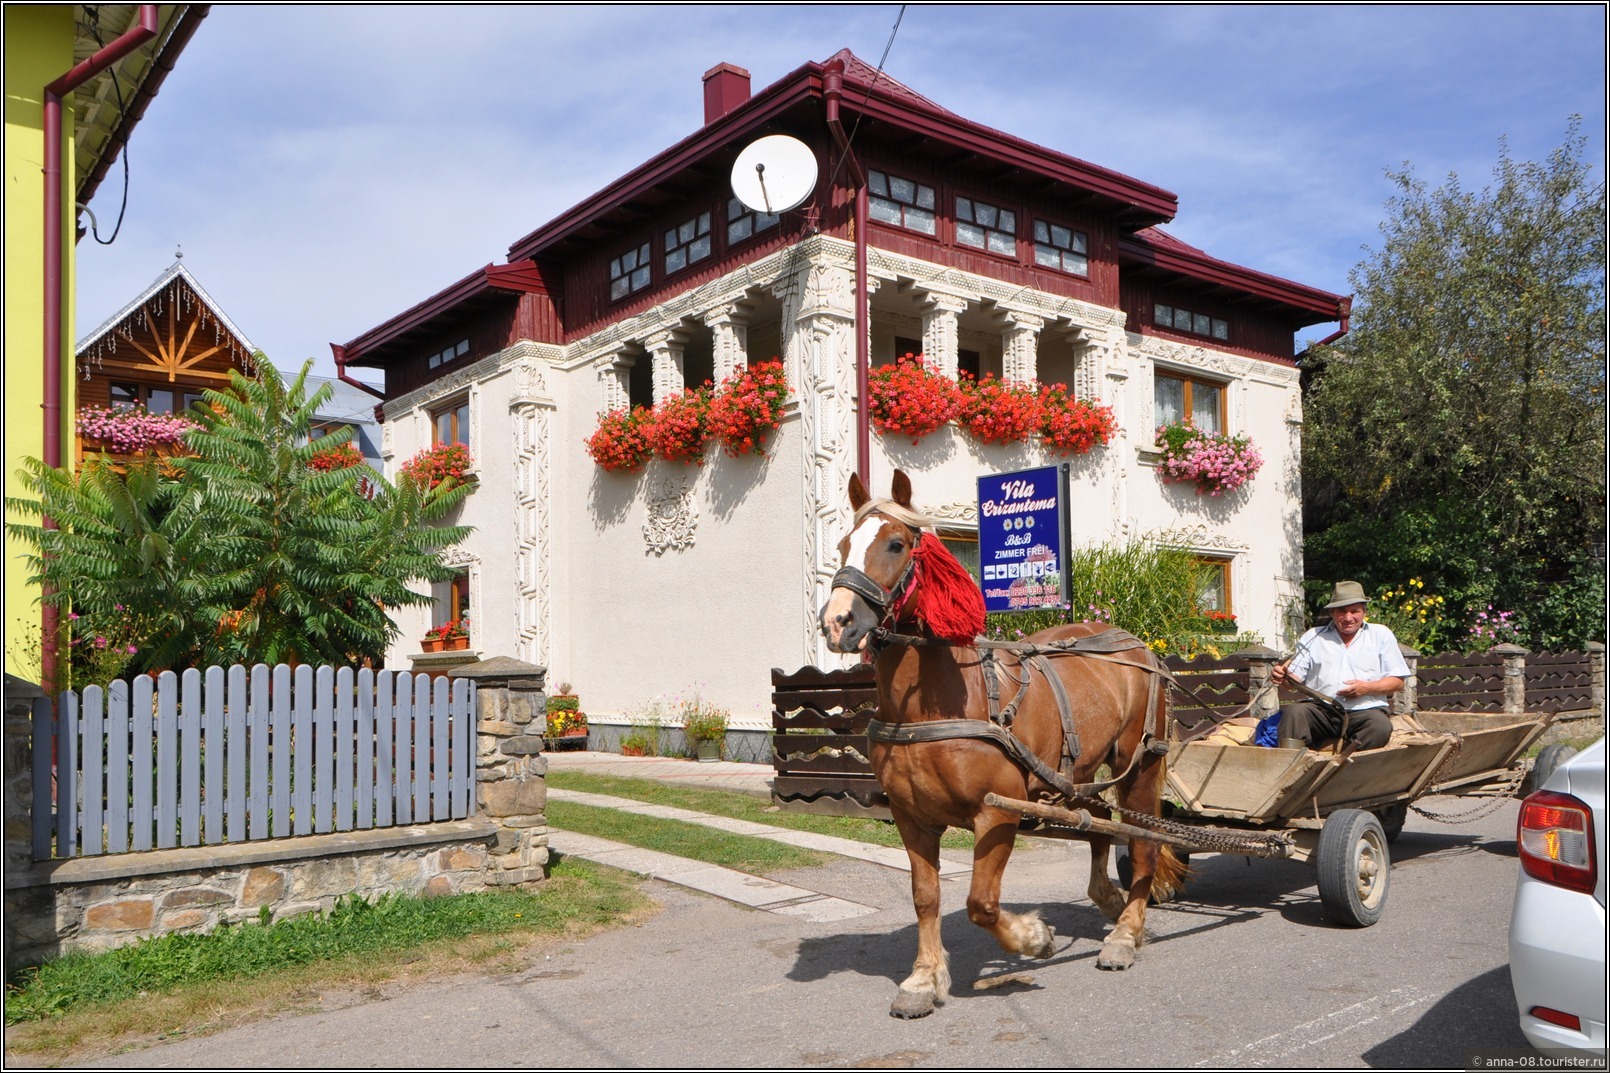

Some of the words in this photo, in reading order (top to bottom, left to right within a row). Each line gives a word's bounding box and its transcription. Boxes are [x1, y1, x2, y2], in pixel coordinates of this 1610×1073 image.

[1001, 480, 1035, 500] Vila
[981, 497, 1056, 517] Crizantema
[1004, 532, 1032, 546] B&B
[995, 549, 1025, 559] ZIMMER
[1026, 546, 1045, 556] FREI
